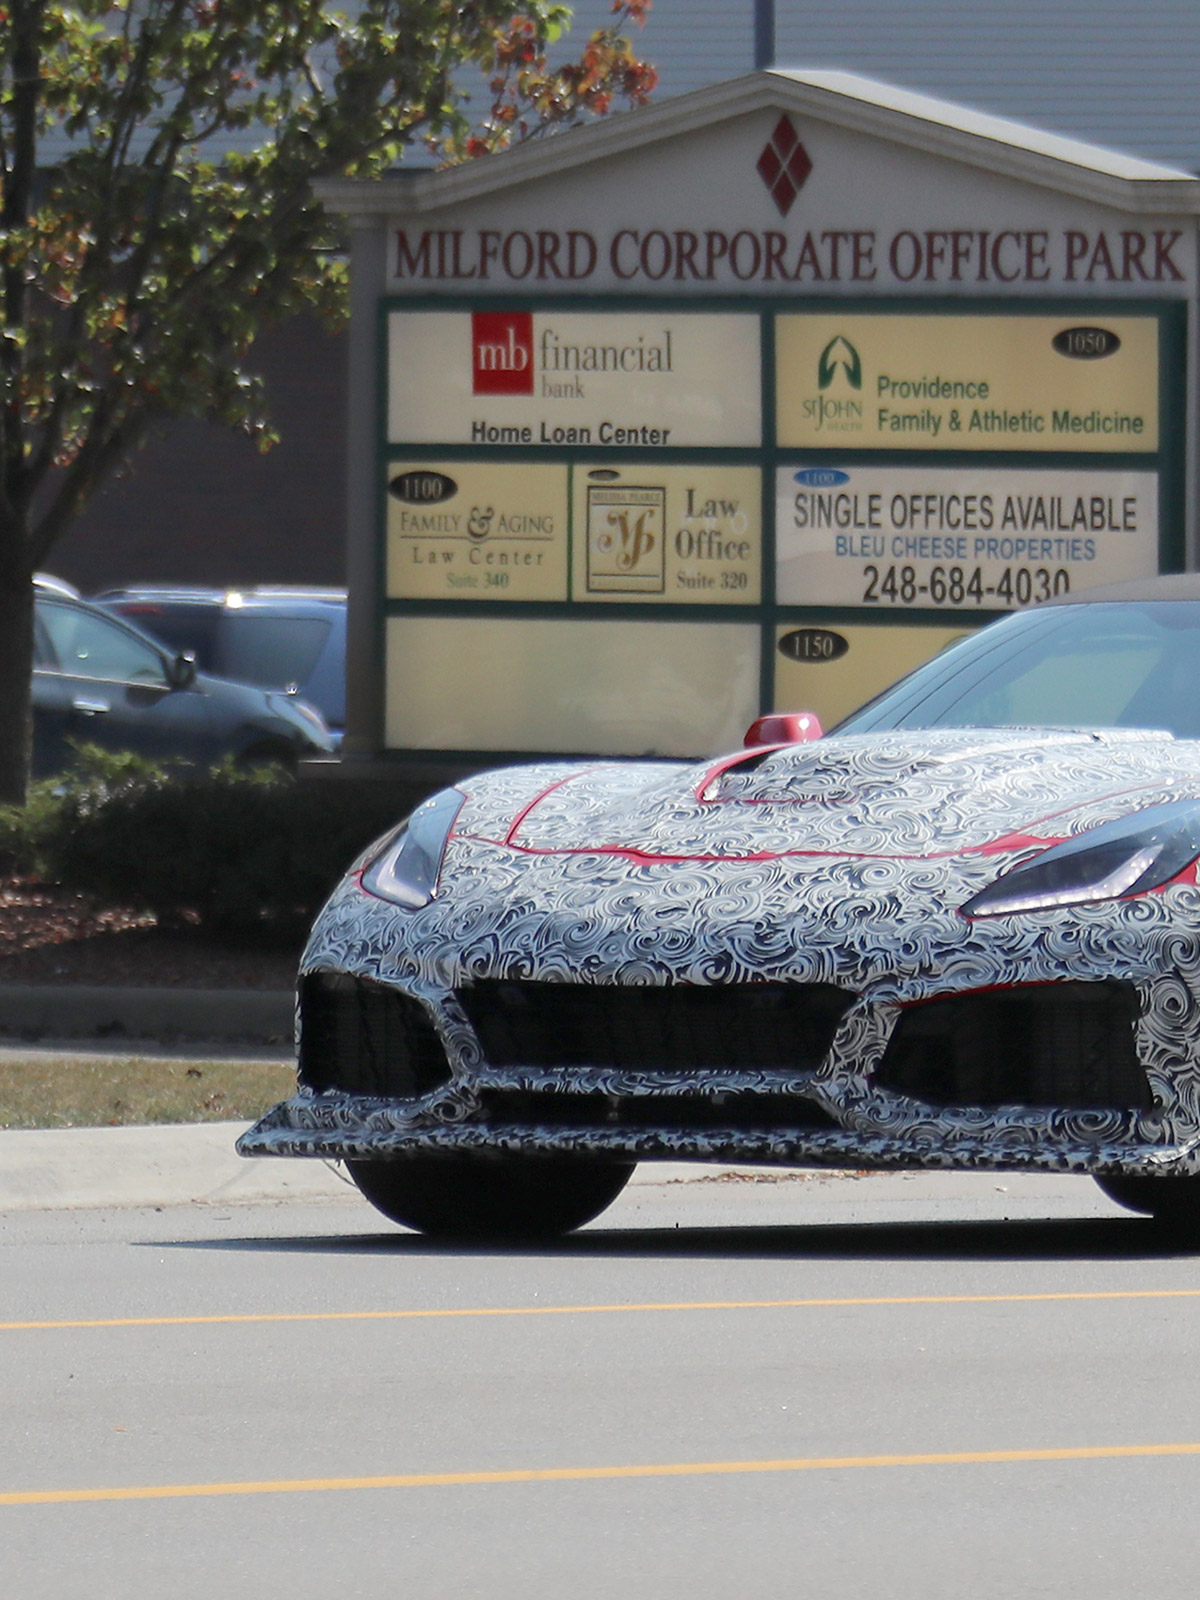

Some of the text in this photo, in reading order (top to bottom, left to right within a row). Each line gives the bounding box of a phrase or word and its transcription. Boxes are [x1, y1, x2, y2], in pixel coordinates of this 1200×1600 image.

[394, 230, 1185, 282] MILFORD CORPORATE OFFICE PARK
[478, 327, 673, 372] mb financial
[1066, 332, 1106, 354] 1050
[541, 375, 585, 399] bank
[878, 375, 989, 400] Providence
[472, 421, 671, 446] Home Loan Center
[878, 410, 1144, 437] Family & Athletic Medicine
[404, 478, 442, 499] 1100
[685, 488, 739, 518] Law
[794, 493, 1137, 533] SINGLE OFFICES AVAILABLE
[401, 506, 553, 539] FAMILY & AGING
[413, 546, 544, 566] Law Center
[675, 529, 752, 560] Office
[836, 535, 1096, 562] BLEU CHEESE PROPERTIES
[446, 573, 509, 589] Suite 340
[677, 571, 748, 590] Suite 320
[863, 565, 1071, 606] 248-684-4030
[793, 633, 833, 659] 1150
